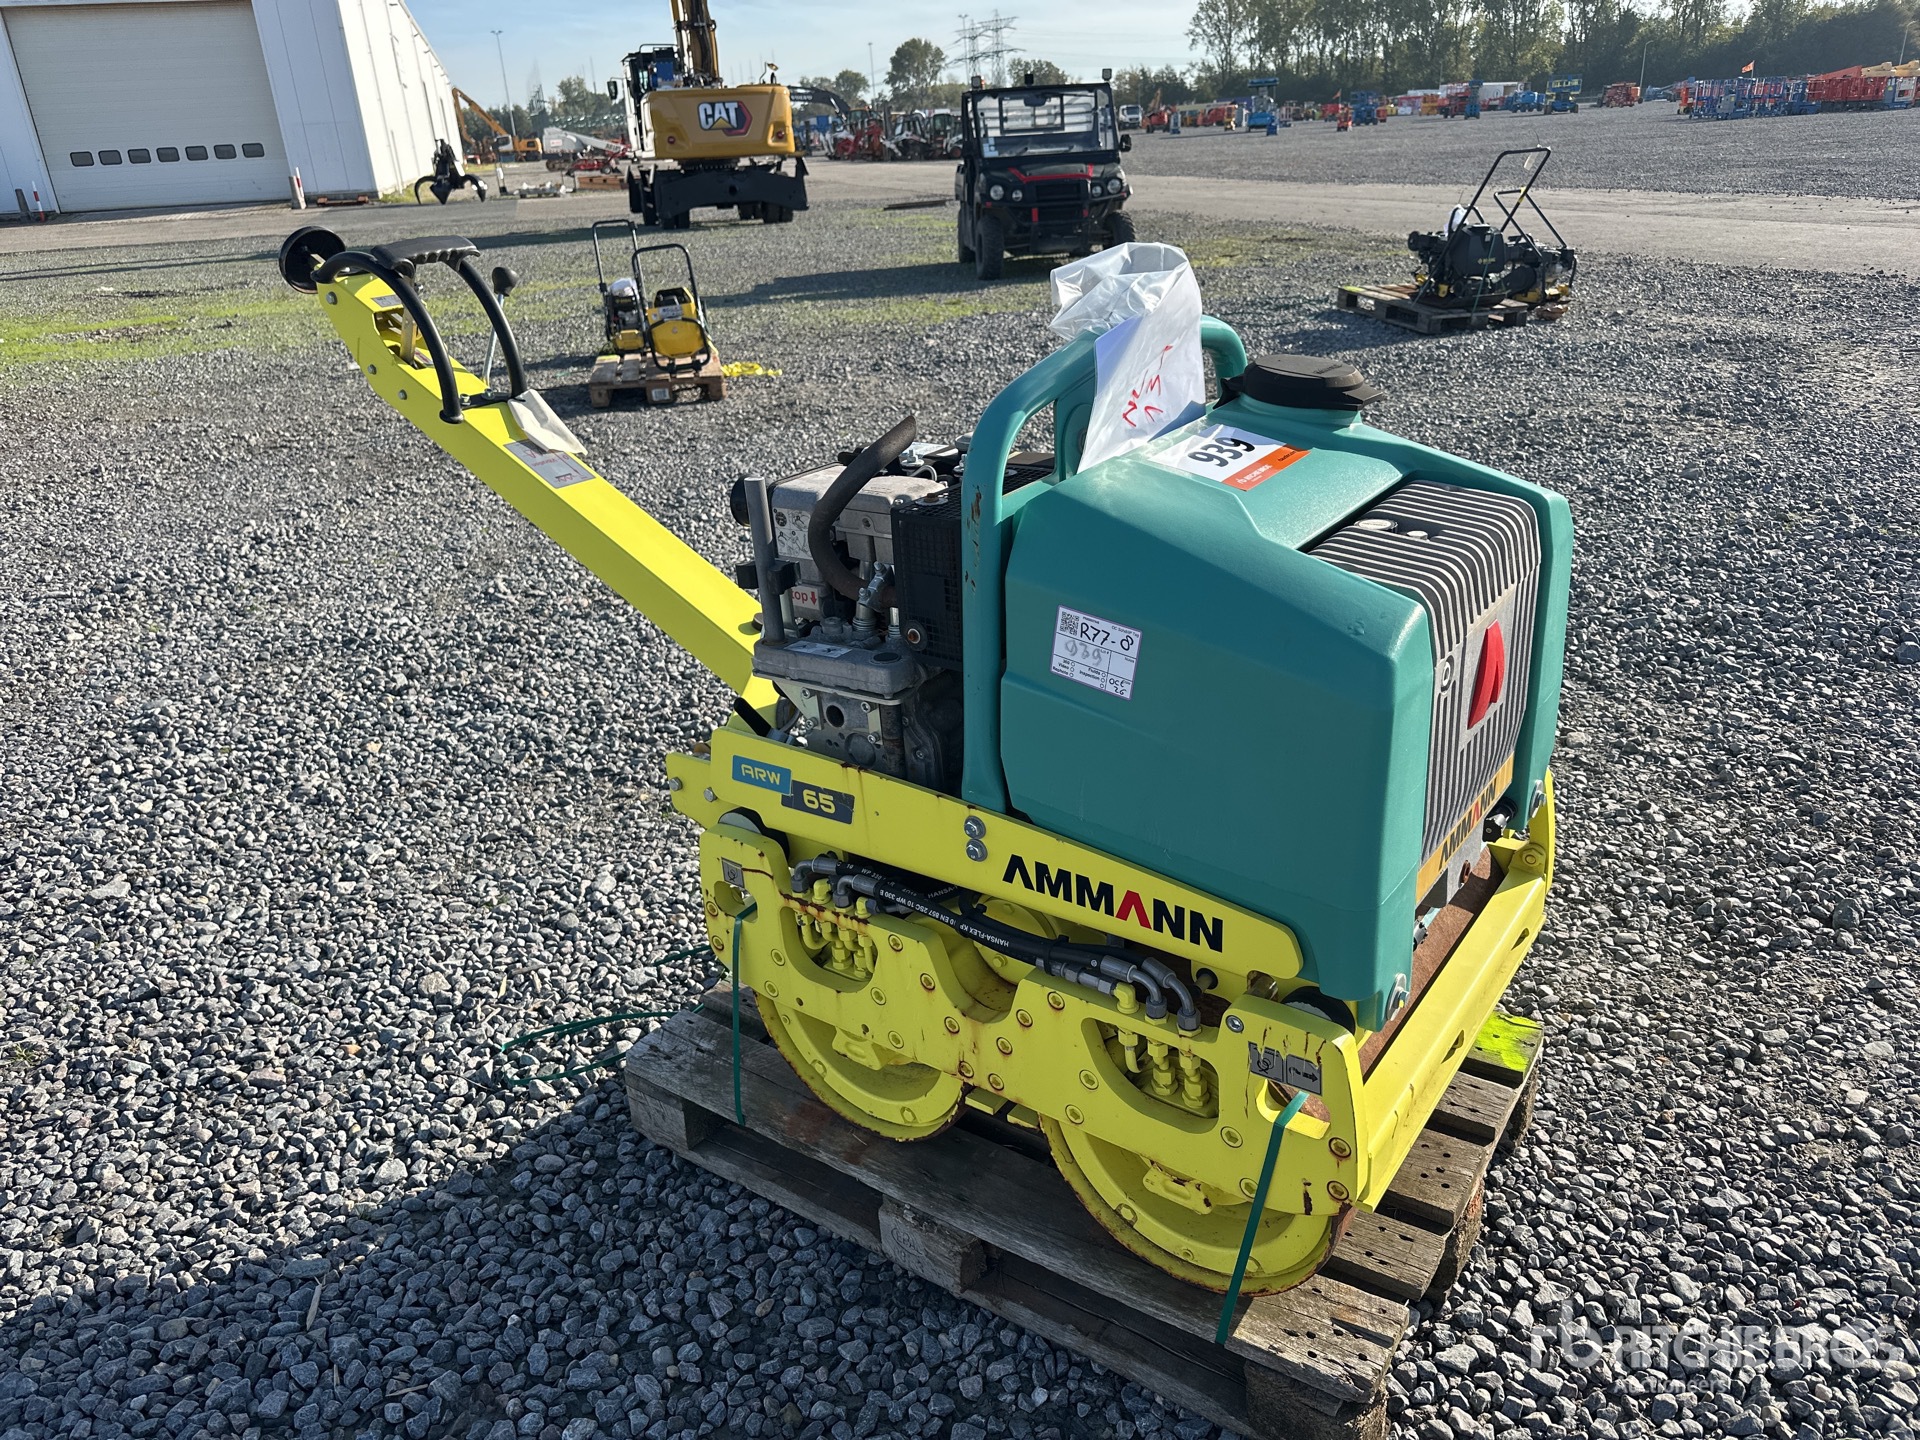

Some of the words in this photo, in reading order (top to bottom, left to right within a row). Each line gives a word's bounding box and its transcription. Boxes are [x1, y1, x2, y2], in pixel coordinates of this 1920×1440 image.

[699, 102, 738, 129] CAT
[1187, 437, 1256, 468] 939
[1080, 670, 1100, 680] Inspection
[741, 764, 781, 785] ARW
[803, 789, 836, 814] 65
[1439, 777, 1497, 872] AMMANN
[884, 891, 896, 900] 330
[896, 896, 907, 905] WP
[1002, 854, 1223, 953] AMMANN
[915, 904, 928, 914] 2SC
[928, 909, 939, 919] 857
[940, 915, 950, 924] EN
[969, 926, 1009, 947] HANSA-FLEX
